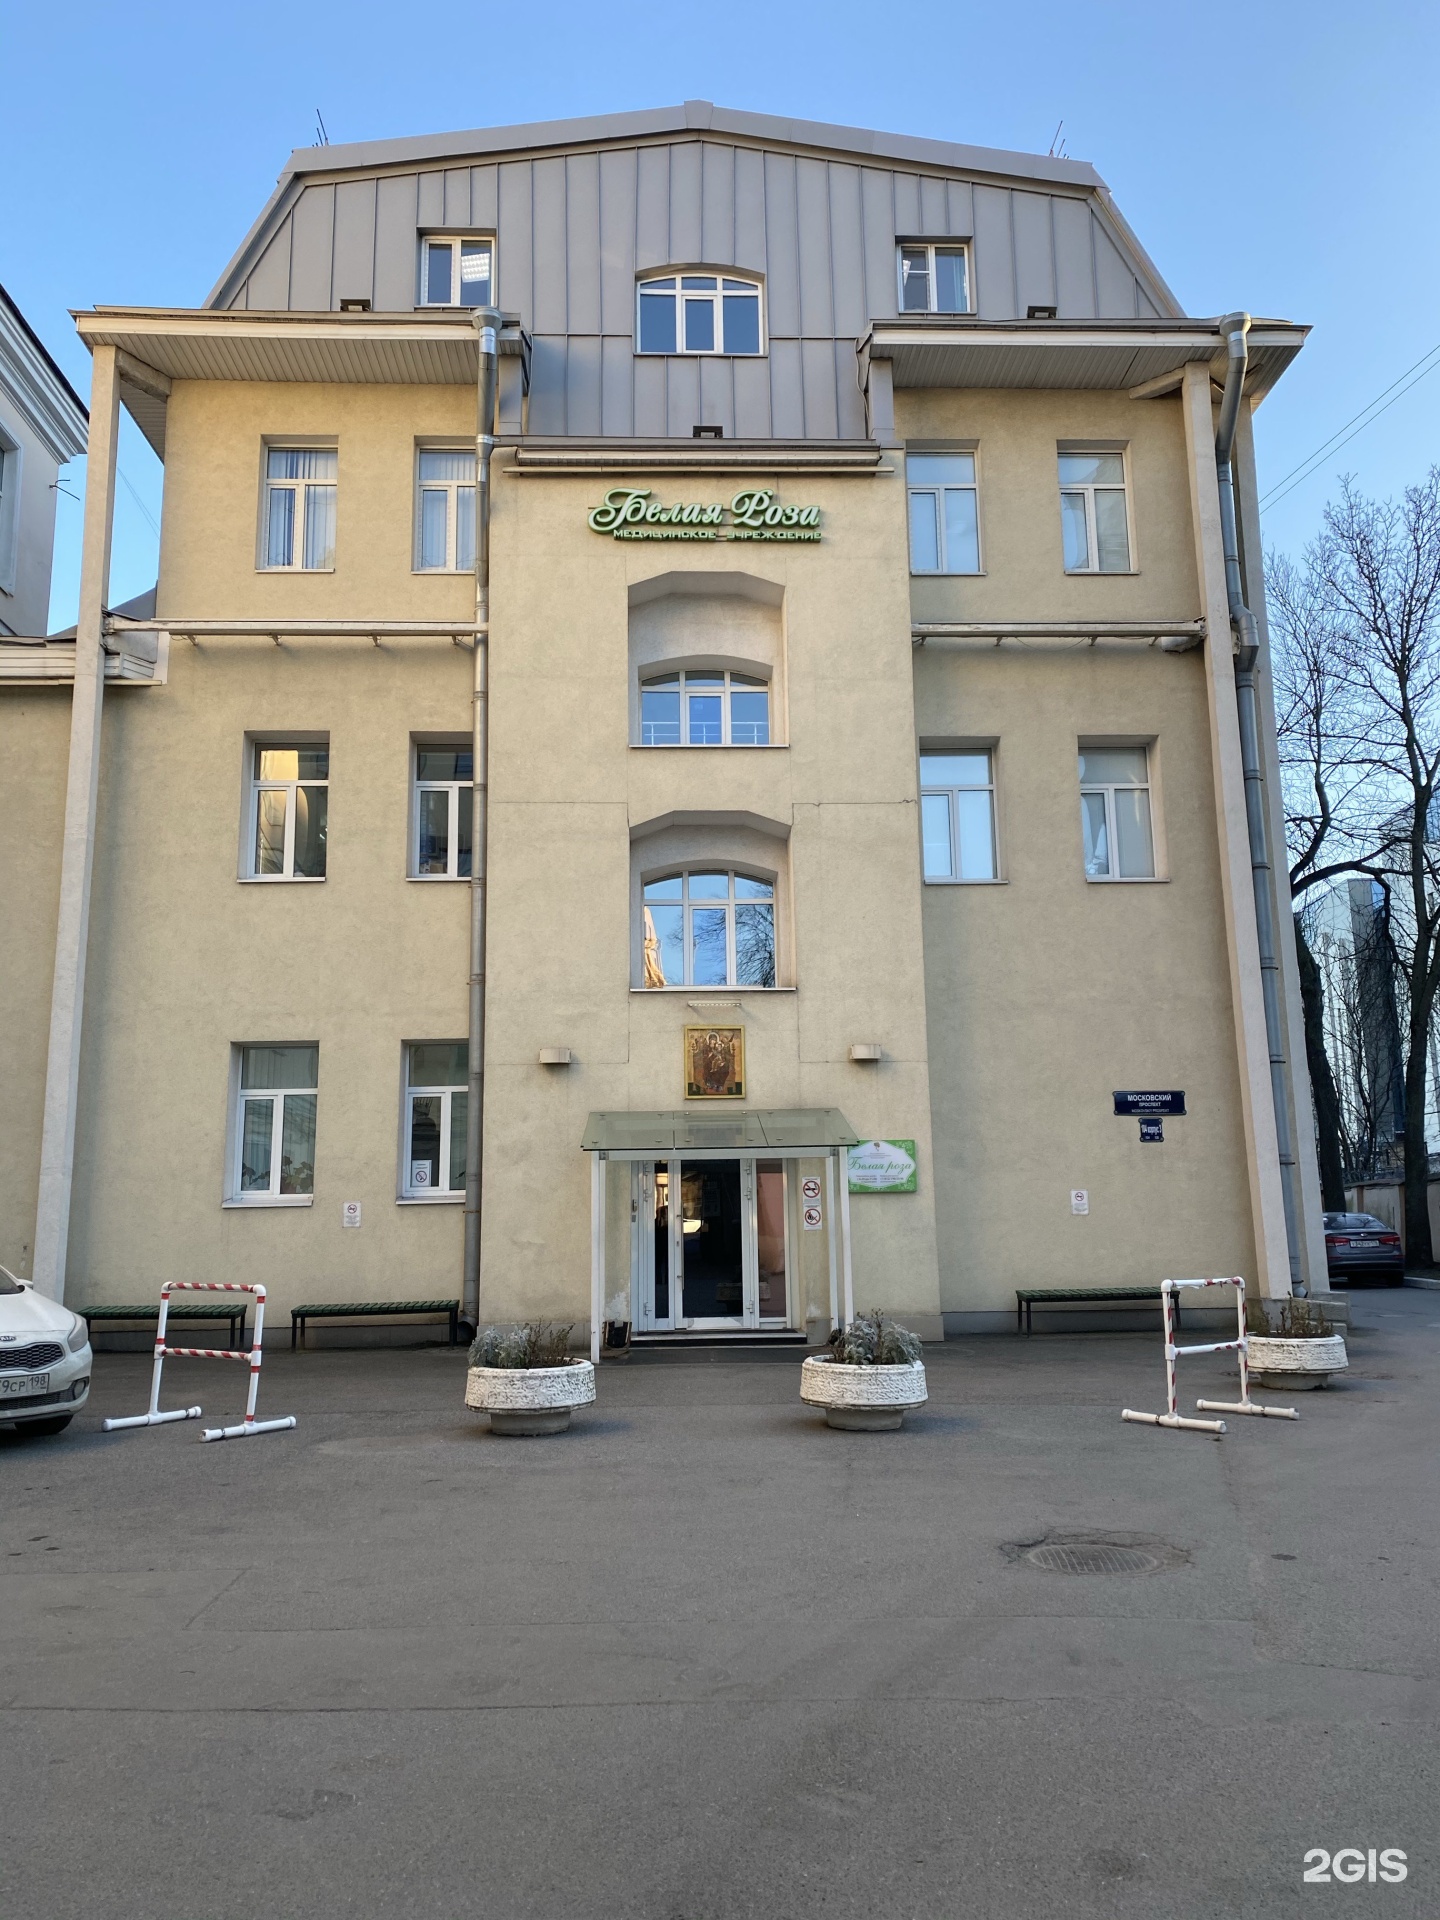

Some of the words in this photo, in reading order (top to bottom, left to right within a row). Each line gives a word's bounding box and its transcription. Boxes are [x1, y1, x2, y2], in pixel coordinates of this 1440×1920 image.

[588, 487, 723, 534] Белая
[731, 488, 821, 530] Роза
[613, 529, 717, 541] МЕДИЦИНСКОЕ
[727, 530, 822, 543] УЧРЕЖДЕНИЕ
[1127, 1094, 1172, 1102] МОСКОВСКИЙ
[848, 1156, 884, 1171] Белая
[885, 1160, 912, 1175] роза
[28, 1375, 47, 1390] 198
